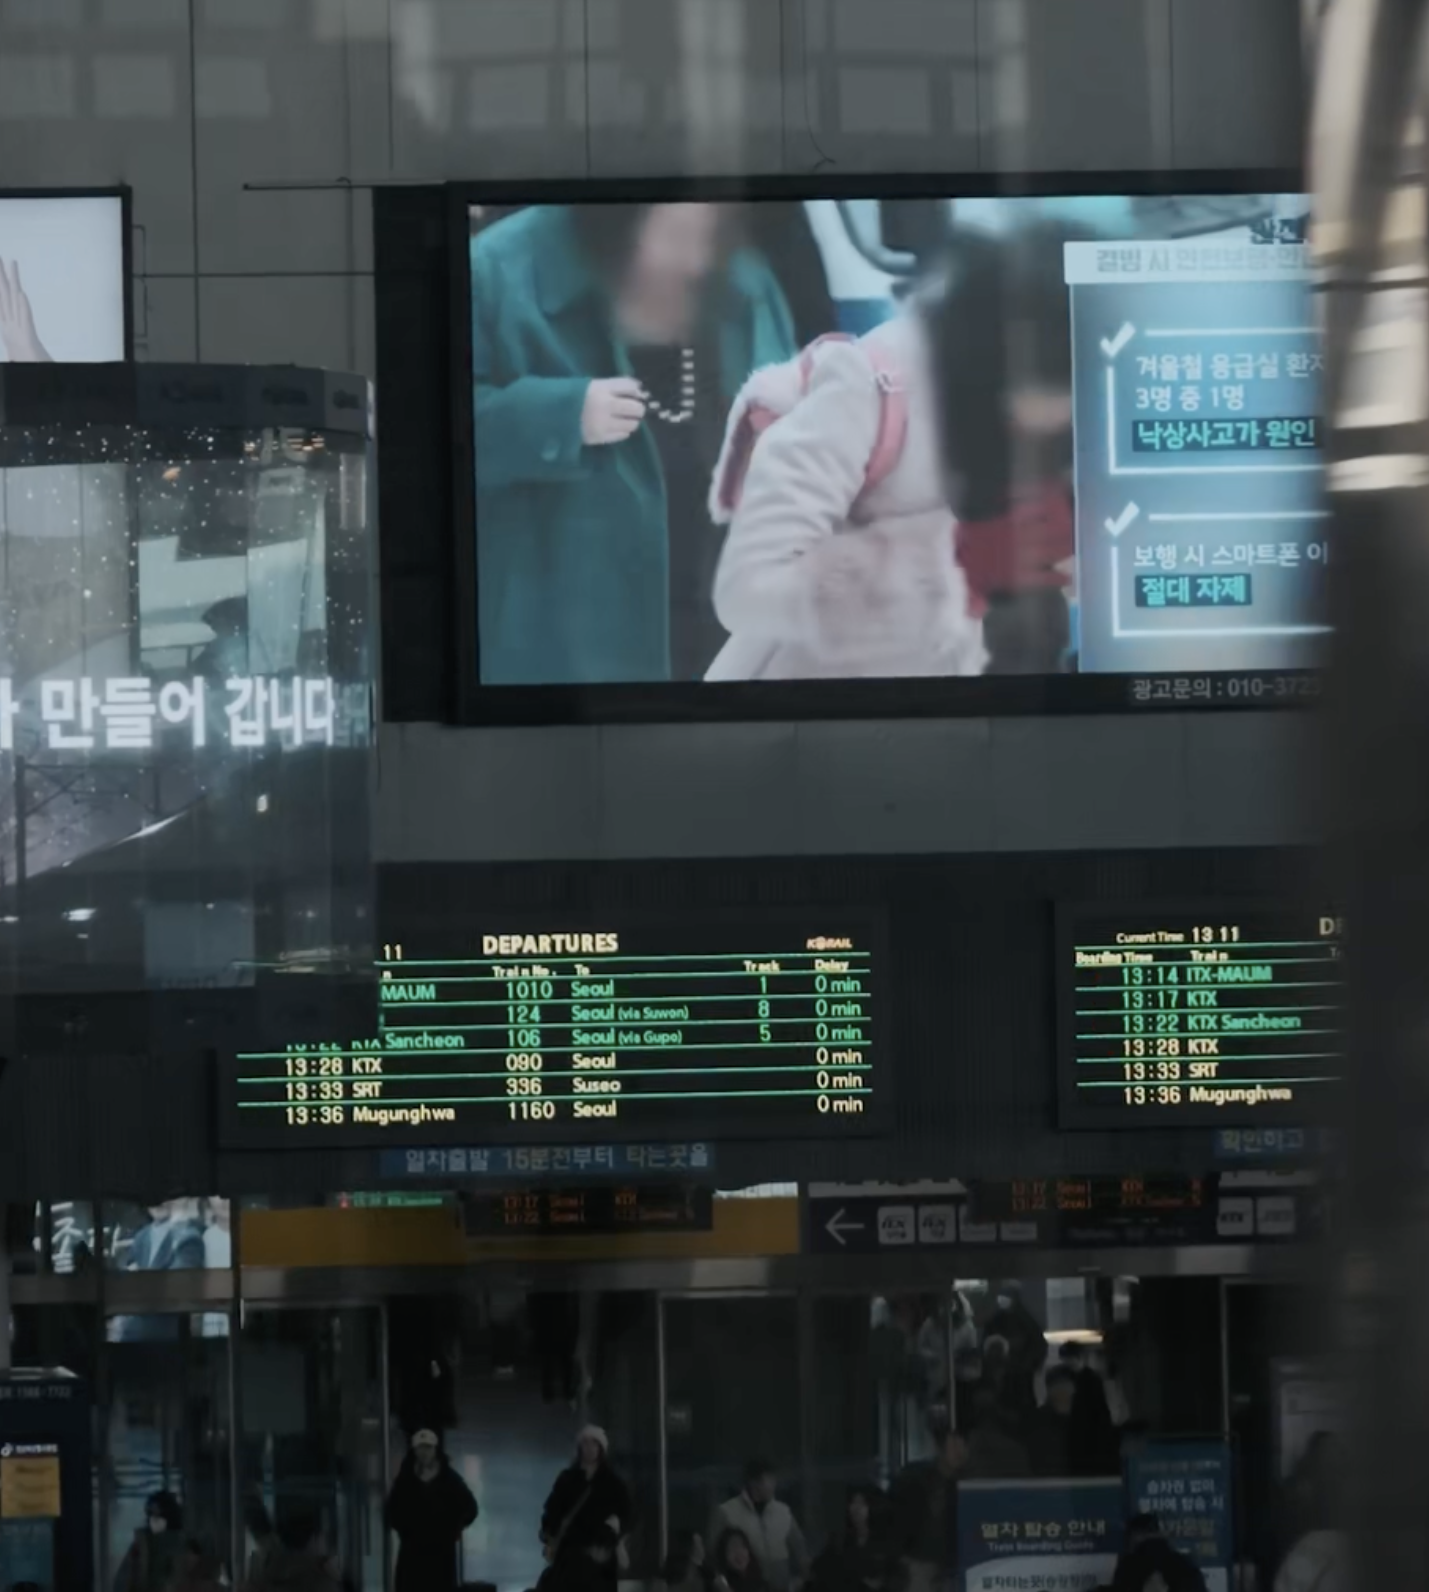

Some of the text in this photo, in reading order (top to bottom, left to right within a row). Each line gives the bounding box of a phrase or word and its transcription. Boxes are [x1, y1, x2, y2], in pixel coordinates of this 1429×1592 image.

[1136, 354, 1203, 381] 겨울철
[1212, 353, 1279, 380] 응급실
[1135, 385, 1244, 411] 3명 중 1명
[1138, 419, 1315, 450] 낙상사고가 원인
[1134, 544, 1177, 570] 보행
[1184, 543, 1204, 567] 시
[1211, 542, 1301, 567] 스마트폰
[1141, 575, 1246, 607] 절대 자제
[1133, 678, 1212, 700] 광고문의
[40, 675, 207, 750] 만들어
[223, 674, 337, 747] 갑니다
[482, 933, 618, 955] DEPARTURES
[1116, 932, 1156, 944] Current
[1158, 931, 1184, 943] Time
[381, 975, 861, 1001] MAUM 1010 Seoul 1 0 min
[1122, 966, 1272, 985] 13:14 ITX-MAUM
[507, 1005, 541, 1023] 124
[571, 1004, 614, 1021] Seoul
[758, 1000, 770, 1018] 8
[815, 999, 827, 1016] 0
[831, 1000, 861, 1017] min
[1122, 990, 1218, 1009] 13:17 KTX
[1123, 1013, 1301, 1033] 13:22 KTX Sancheon
[385, 1031, 465, 1050] Sancheon
[507, 1029, 541, 1047] 106
[571, 1028, 615, 1045] Seoul
[643, 1030, 682, 1046] Gupo)
[760, 1024, 771, 1043] 5
[816, 1023, 827, 1040] 0
[832, 1024, 862, 1041] min
[1123, 1038, 1219, 1057] 13:28 KTX
[285, 1047, 862, 1076] 13:28 KTX 090 Seoul 0 min
[1123, 1062, 1219, 1081] 13:33 SRT
[285, 1071, 862, 1101] 13:33 SRT 336 Suseo 0 min
[1124, 1085, 1292, 1106] 13:36 Mugunghwa
[285, 1095, 863, 1126] 13:36 Mugunghwa 1160 Seoul 0 min
[505, 1146, 614, 1171] 15분전부터
[626, 1144, 709, 1169] 타는곳을
